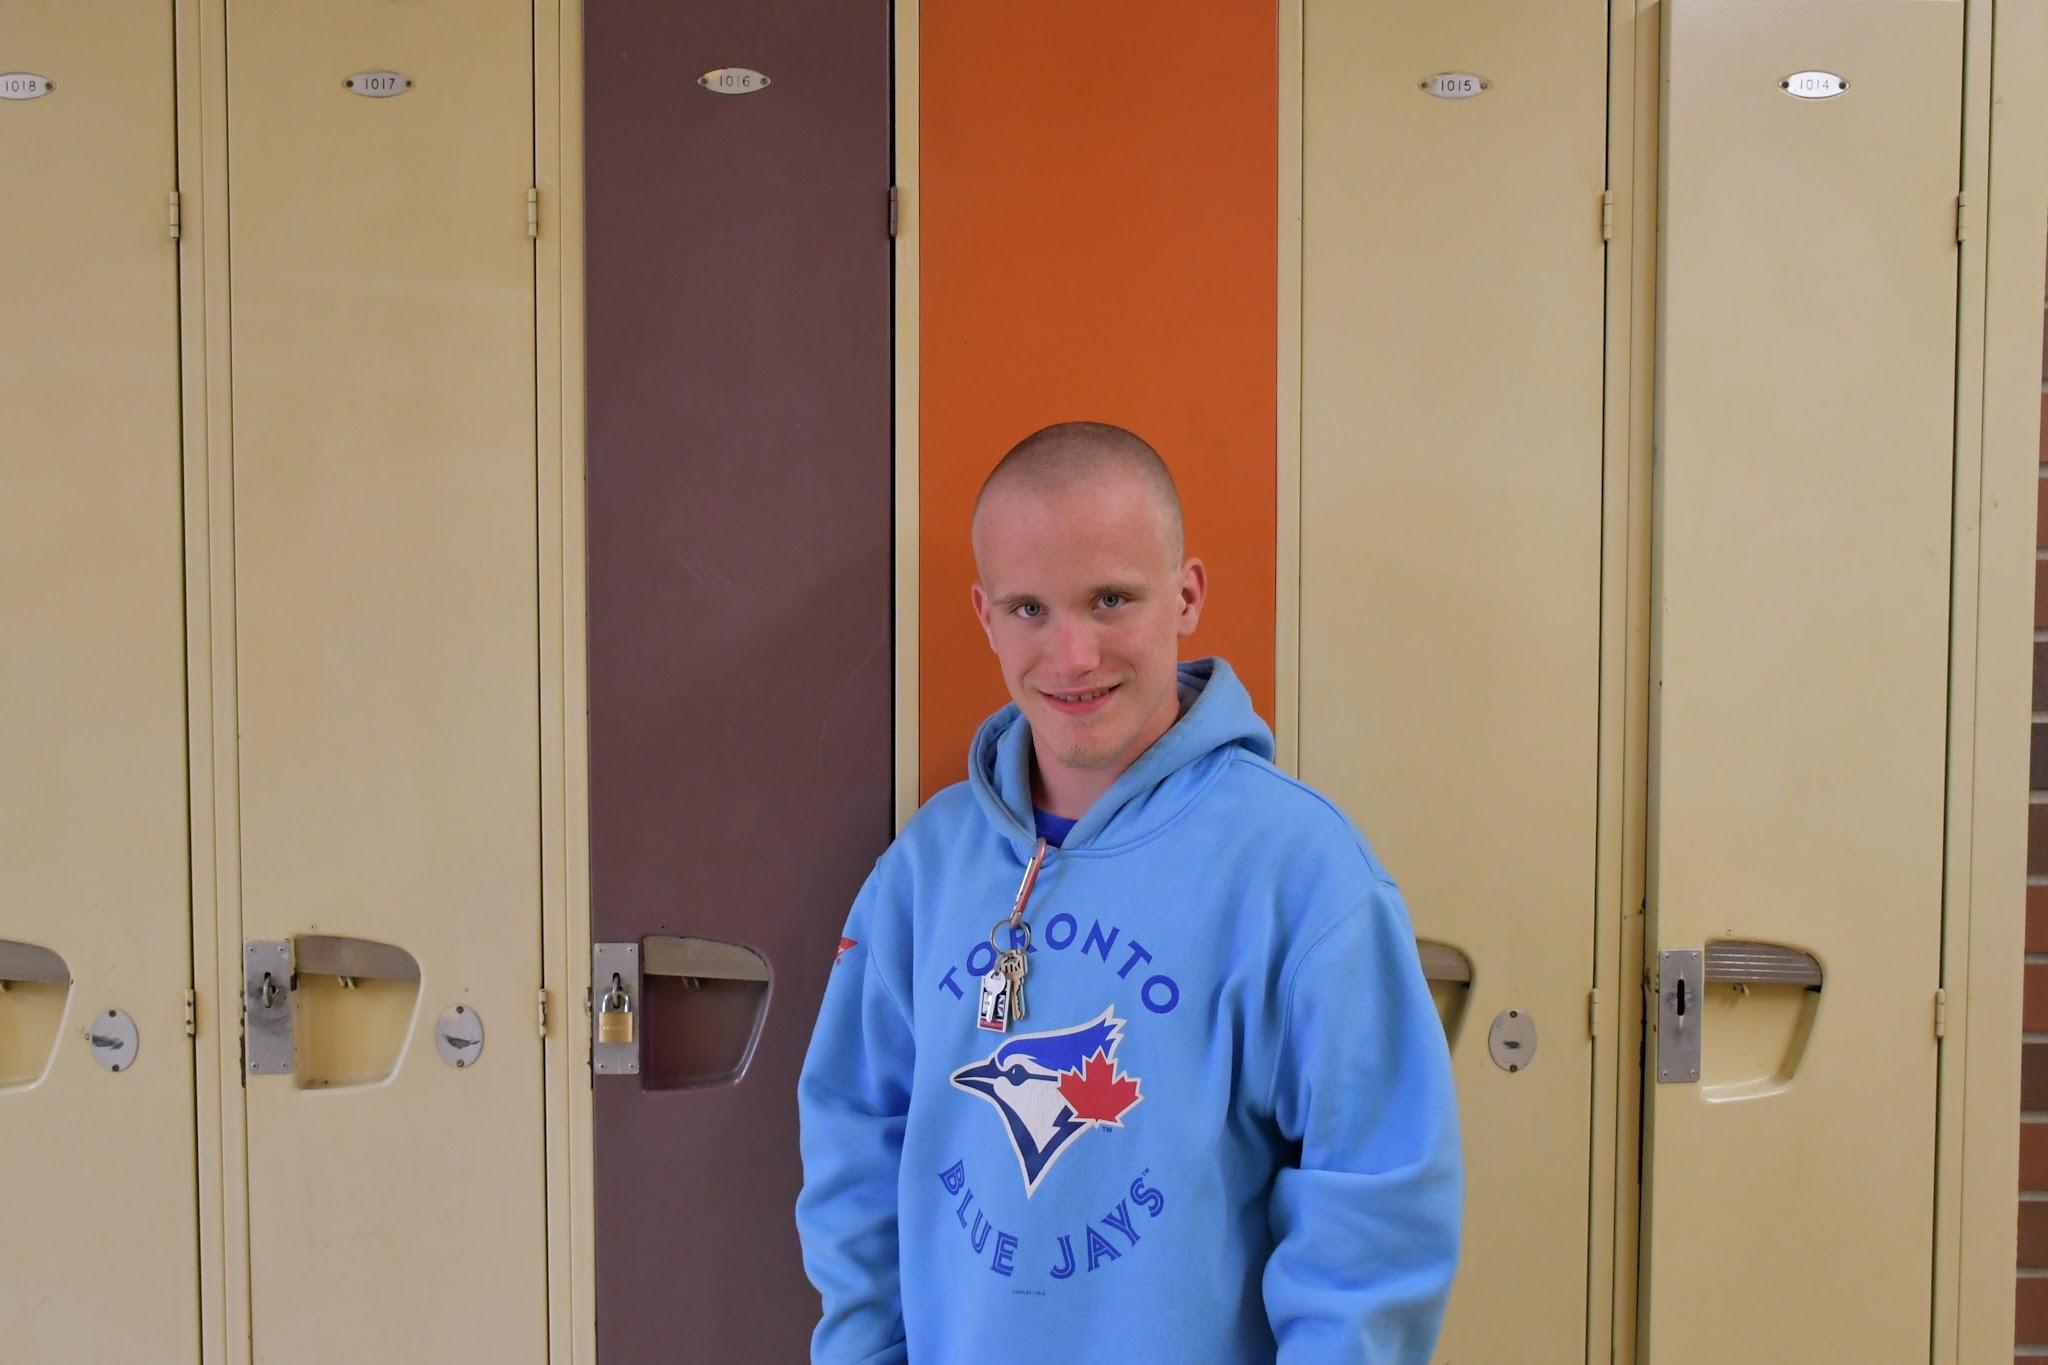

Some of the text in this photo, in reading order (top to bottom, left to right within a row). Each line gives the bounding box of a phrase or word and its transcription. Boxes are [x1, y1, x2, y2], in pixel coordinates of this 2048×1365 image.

[5, 80, 37, 92] 1018
[365, 78, 396, 90] 1017
[720, 75, 751, 87] 1016
[1441, 79, 1472, 92] 1015
[1800, 79, 1829, 91] 1014
[938, 913, 1180, 1014] TORONTO
[938, 1158, 1019, 1277] BLUE
[1049, 1176, 1165, 1280] JAYS
